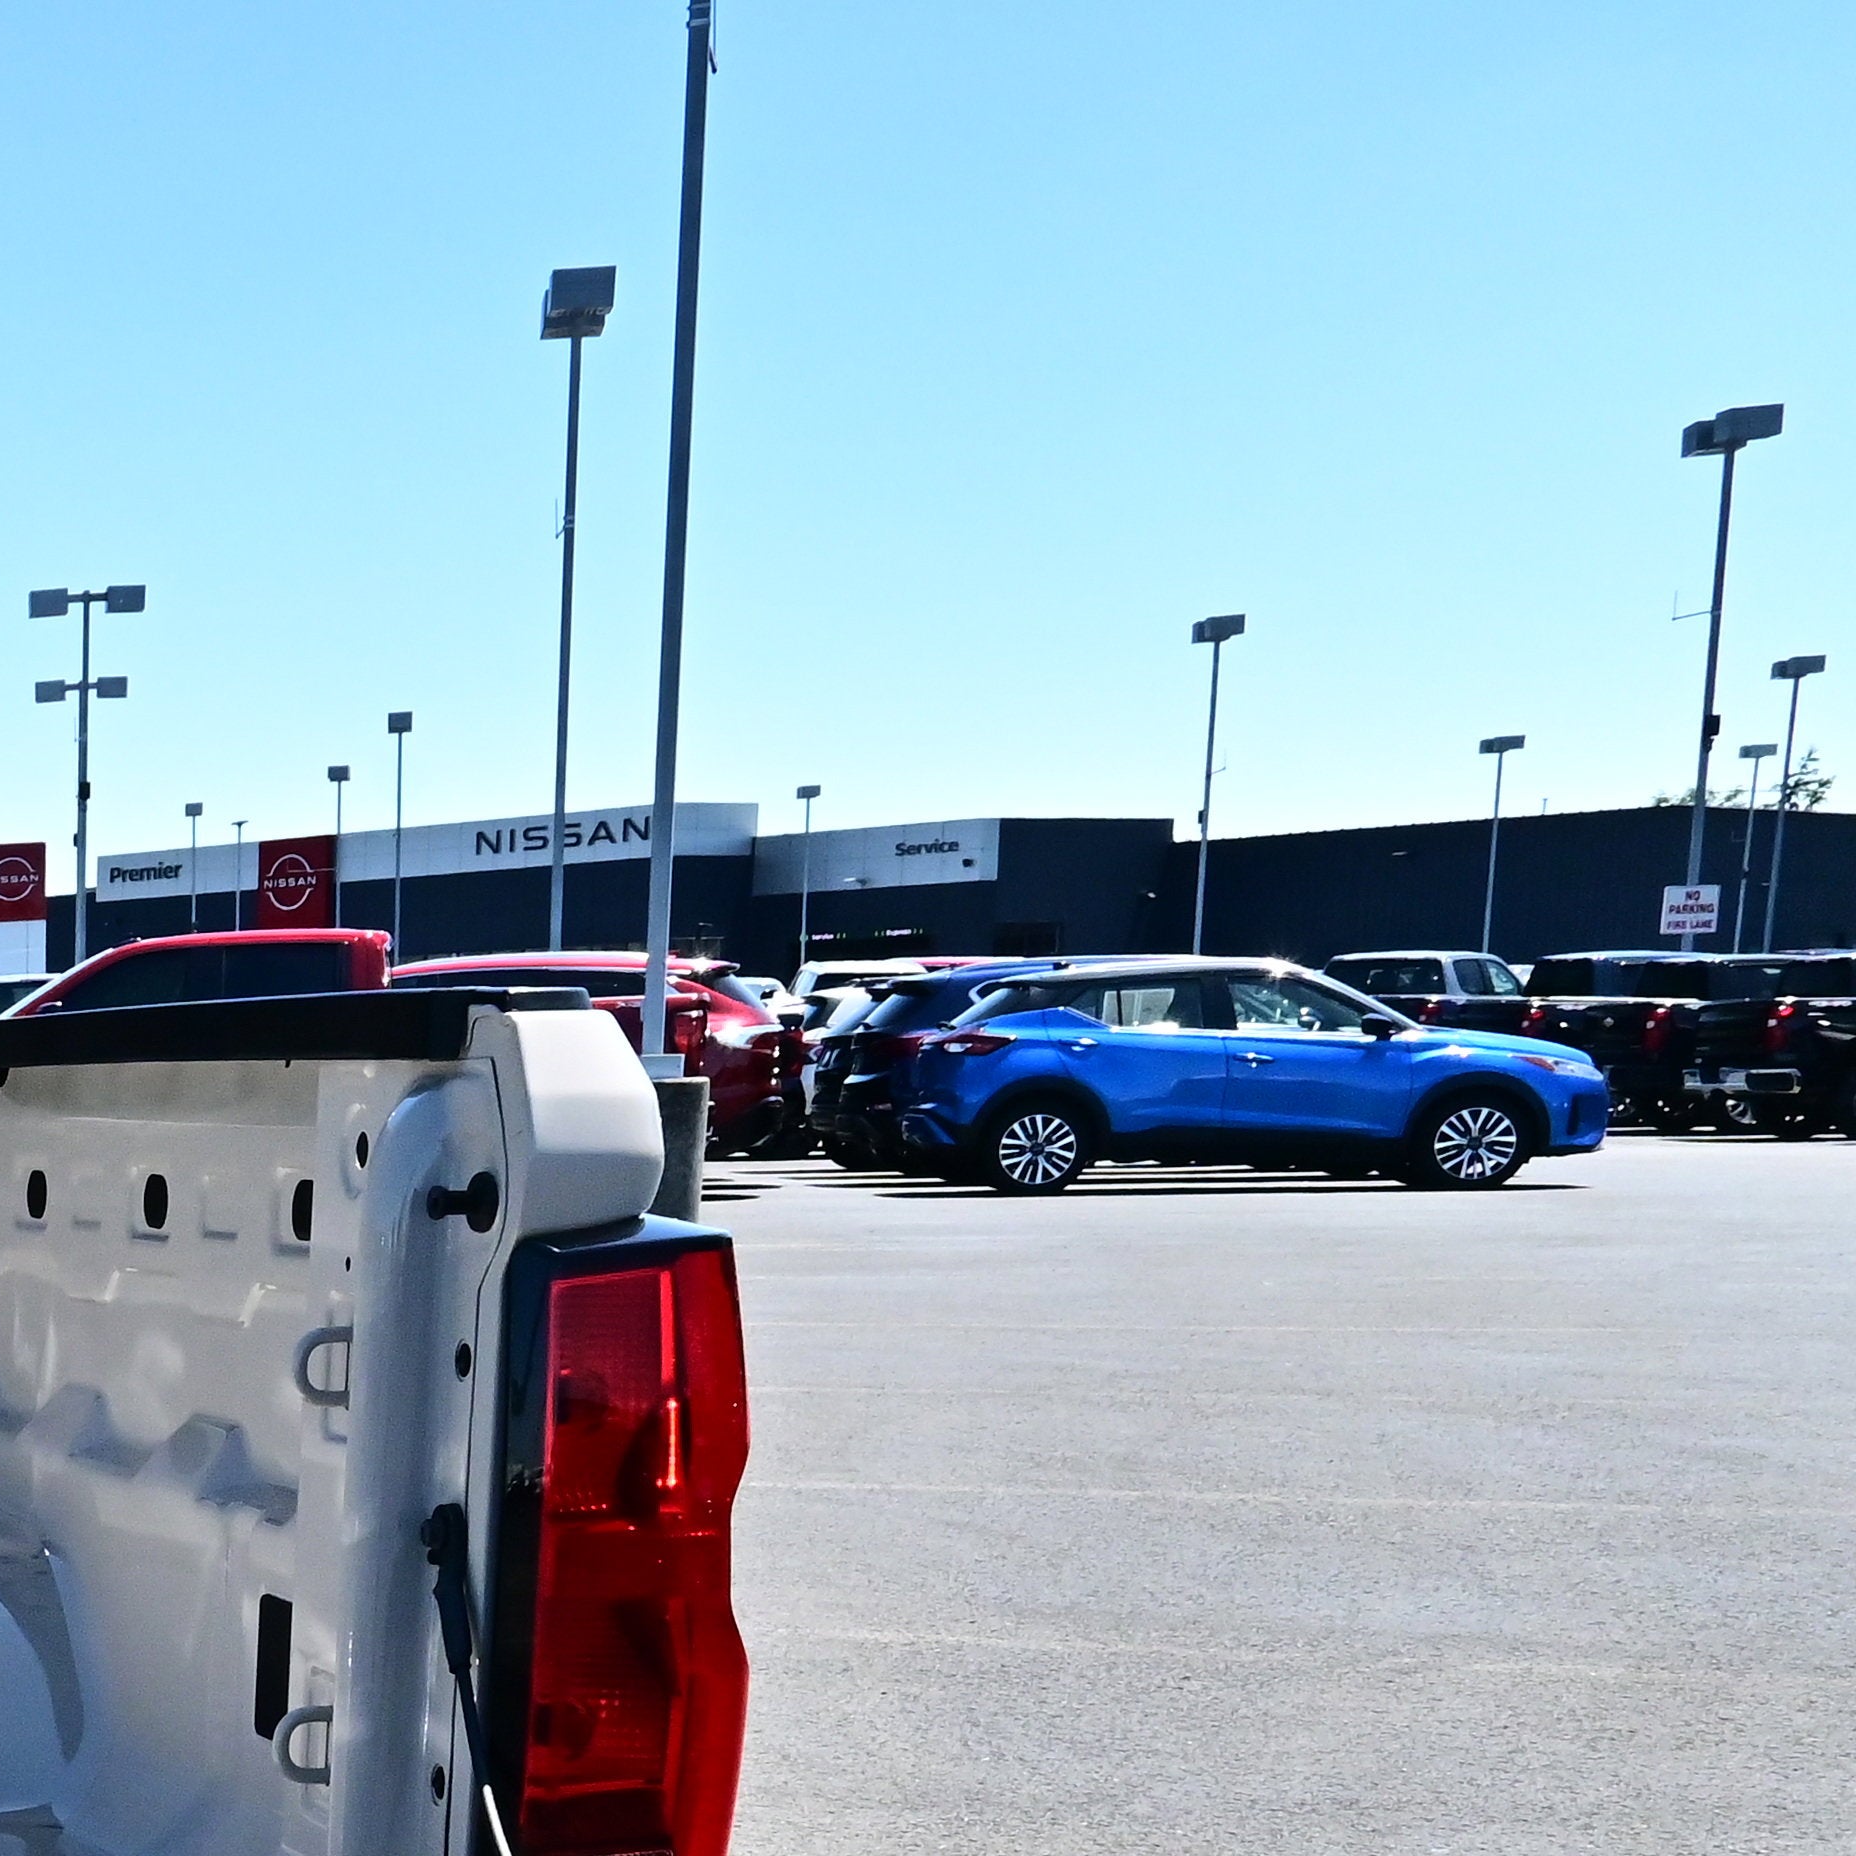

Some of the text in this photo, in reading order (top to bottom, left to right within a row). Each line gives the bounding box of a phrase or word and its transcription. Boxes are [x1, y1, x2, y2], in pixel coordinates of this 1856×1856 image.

[475, 816, 652, 856] NISSAN
[895, 838, 960, 857] Service
[109, 861, 183, 884] Premier
[263, 875, 317, 891] NISSAN
[1685, 890, 1700, 900] NO
[1669, 903, 1714, 913] PARKING
[1667, 919, 1713, 929] FIRE LANE
